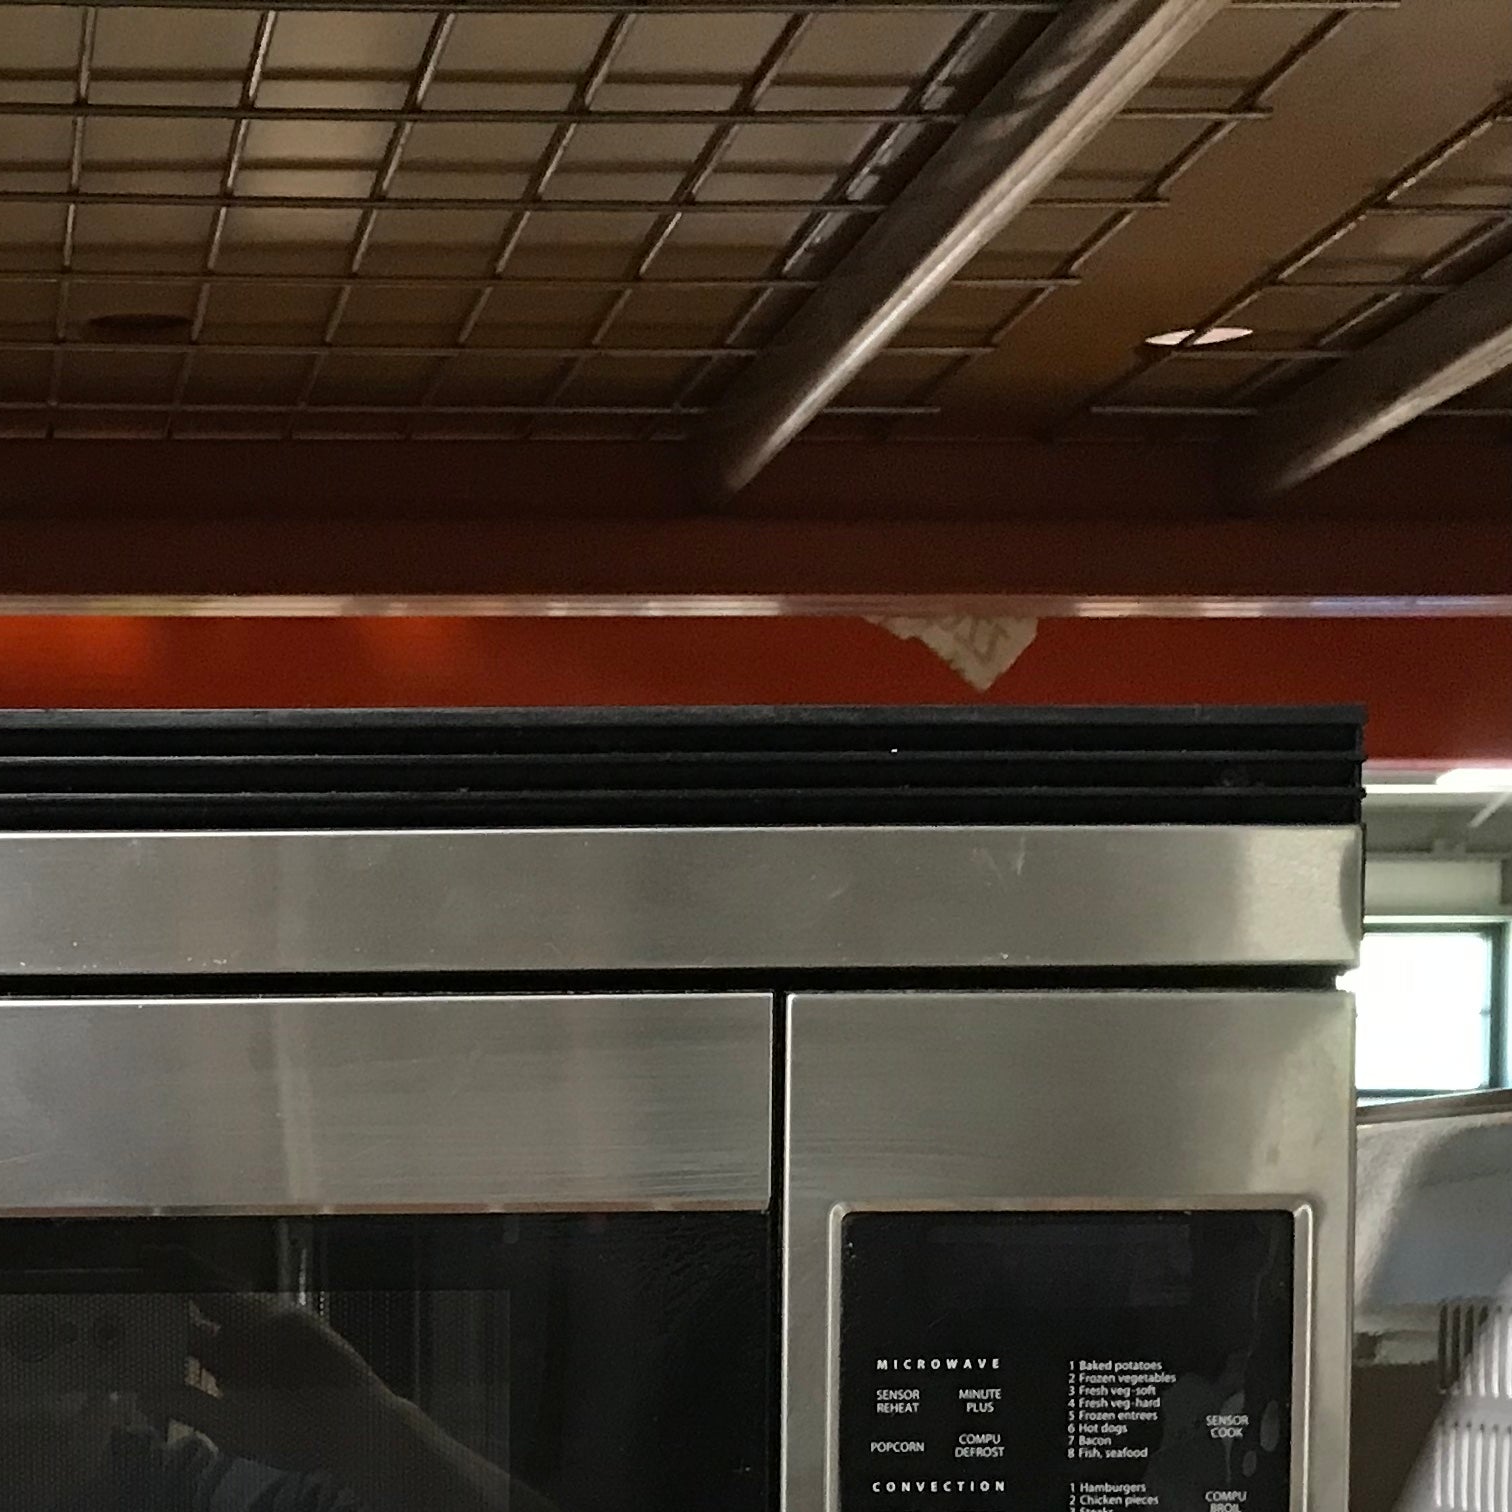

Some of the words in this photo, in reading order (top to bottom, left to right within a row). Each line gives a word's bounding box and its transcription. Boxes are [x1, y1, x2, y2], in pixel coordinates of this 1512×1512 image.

[877, 1359, 1000, 1370] MICROWAVE
[1069, 1361, 1075, 1371] 1
[1079, 1361, 1112, 1371] Baked
[1115, 1361, 1162, 1373] potatoes
[1068, 1374, 1075, 1383] 2
[1079, 1374, 1115, 1383] Frozen
[1118, 1374, 1176, 1386] vegetables
[876, 1390, 920, 1400] SENSOR
[959, 1389, 1001, 1399] MINUTE
[1068, 1387, 1075, 1396] 3
[1079, 1386, 1108, 1396] Fresh
[877, 1403, 919, 1413] REHEAT
[967, 1402, 994, 1412] PLUS
[1068, 1399, 1075, 1408] 4
[1079, 1398, 1108, 1408] Fresh
[1068, 1411, 1075, 1420] 5
[1079, 1411, 1115, 1420] Frozen
[1118, 1411, 1158, 1420] entrees
[1206, 1415, 1248, 1426] SENSOR
[1068, 1424, 1075, 1433] 6
[1078, 1423, 1098, 1433] Hot
[1101, 1423, 1127, 1436] dogs
[1211, 1428, 1243, 1438] COOK
[959, 1434, 1000, 1445] COMPU
[1068, 1436, 1075, 1446] 7
[1079, 1436, 1111, 1446] Bacon
[871, 1442, 924, 1452] POPCORN
[955, 1447, 1004, 1458] DEFROST
[1068, 1449, 1075, 1458] 8
[1078, 1448, 1102, 1459] Fish,
[1105, 1448, 1148, 1458] seafood
[872, 1481, 1004, 1492] CONVECTION
[1069, 1484, 1075, 1493] 1
[1080, 1483, 1146, 1496] Hamburgers
[1068, 1496, 1075, 1505] 2
[1079, 1495, 1122, 1505] Chicken
[1125, 1495, 1158, 1508] pieces
[1205, 1492, 1247, 1502] COMPU
